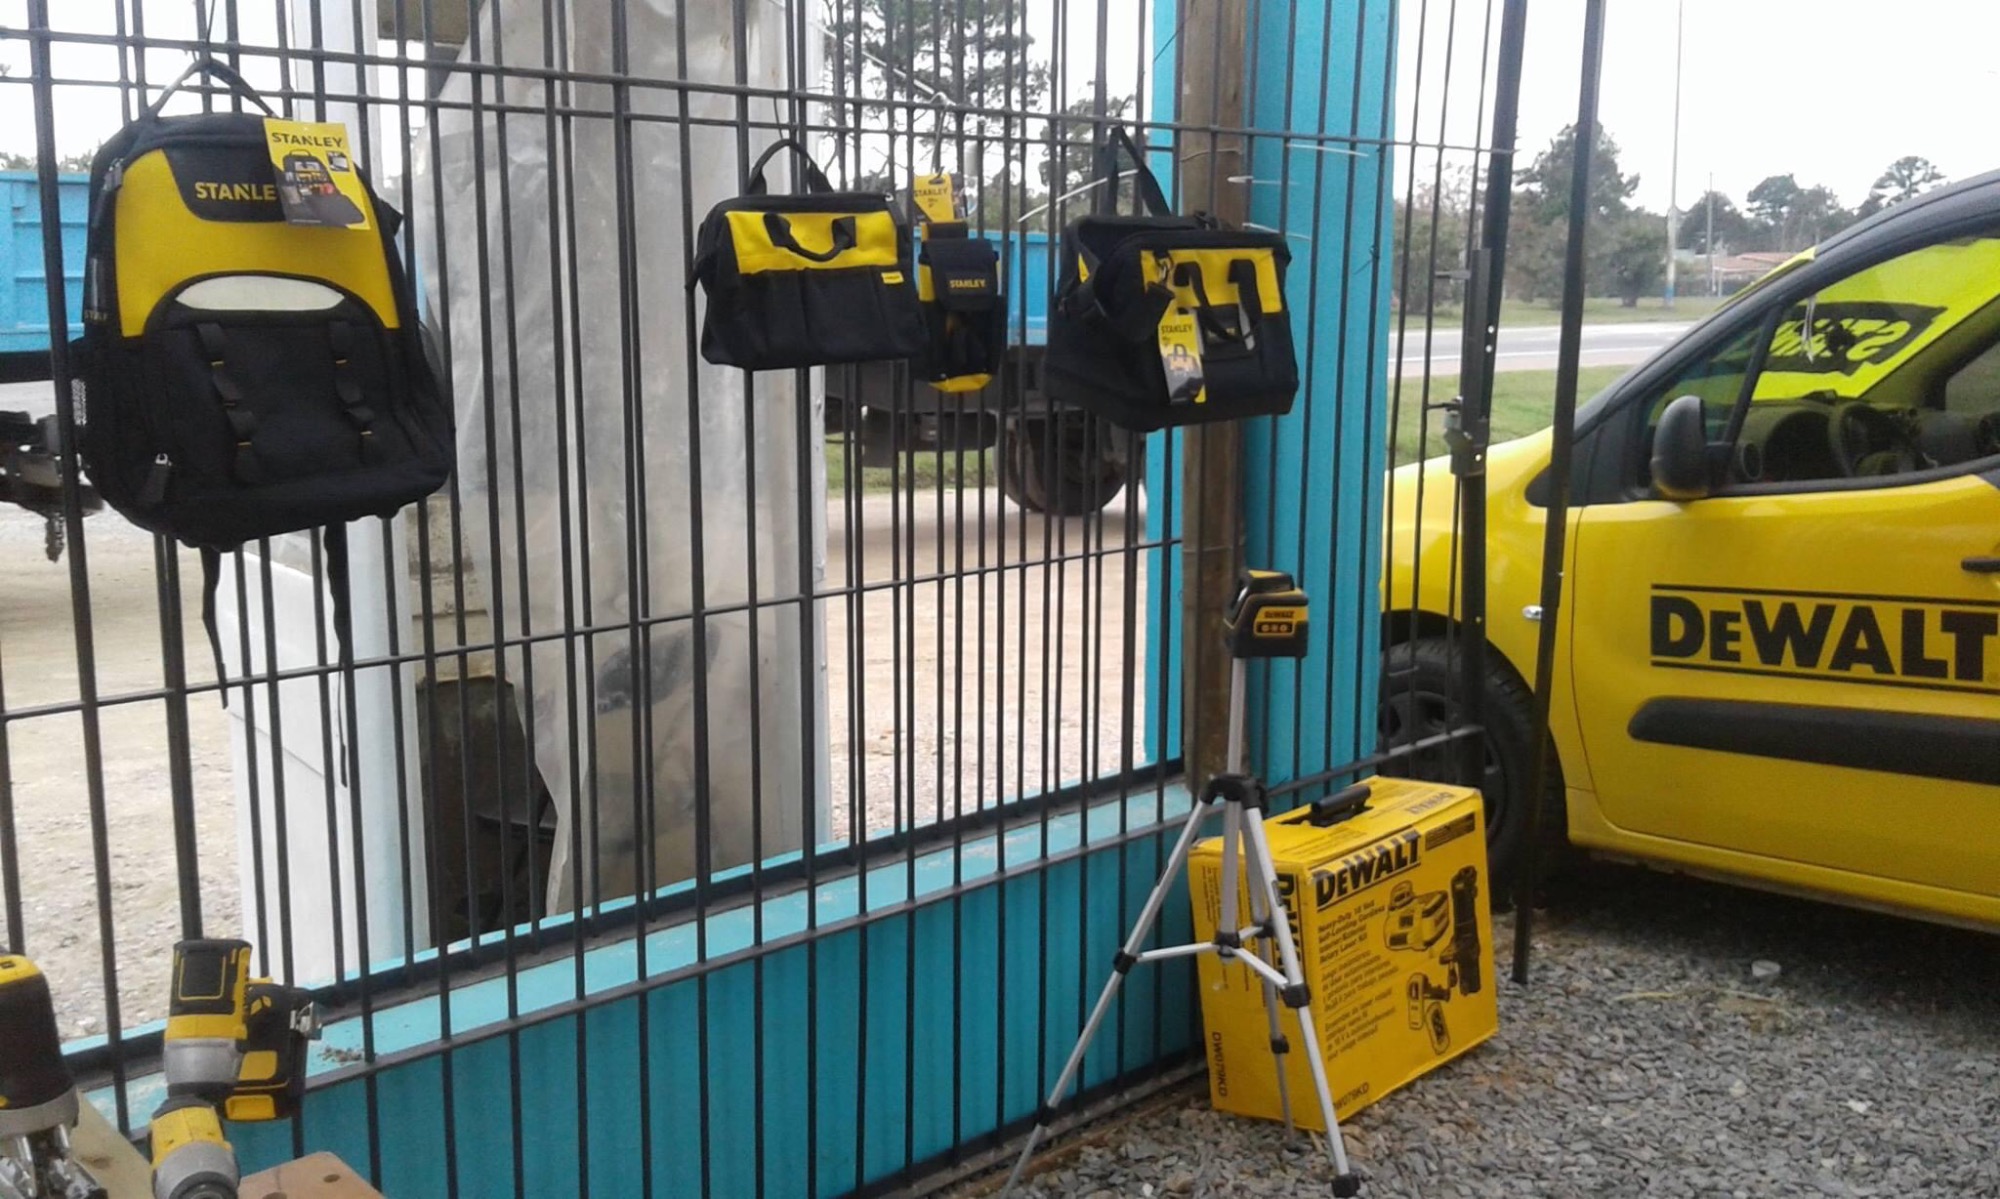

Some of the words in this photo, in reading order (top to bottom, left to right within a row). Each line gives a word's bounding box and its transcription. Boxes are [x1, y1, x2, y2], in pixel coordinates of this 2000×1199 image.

[272, 132, 344, 148] STANLEY
[195, 182, 278, 201] STANLE
[914, 187, 948, 198] STANLEY
[949, 279, 986, 289] STANLEY
[1161, 324, 1193, 335] STANLEY
[1651, 595, 1999, 681] DEWALT
[1312, 830, 1421, 907] DEWALT
